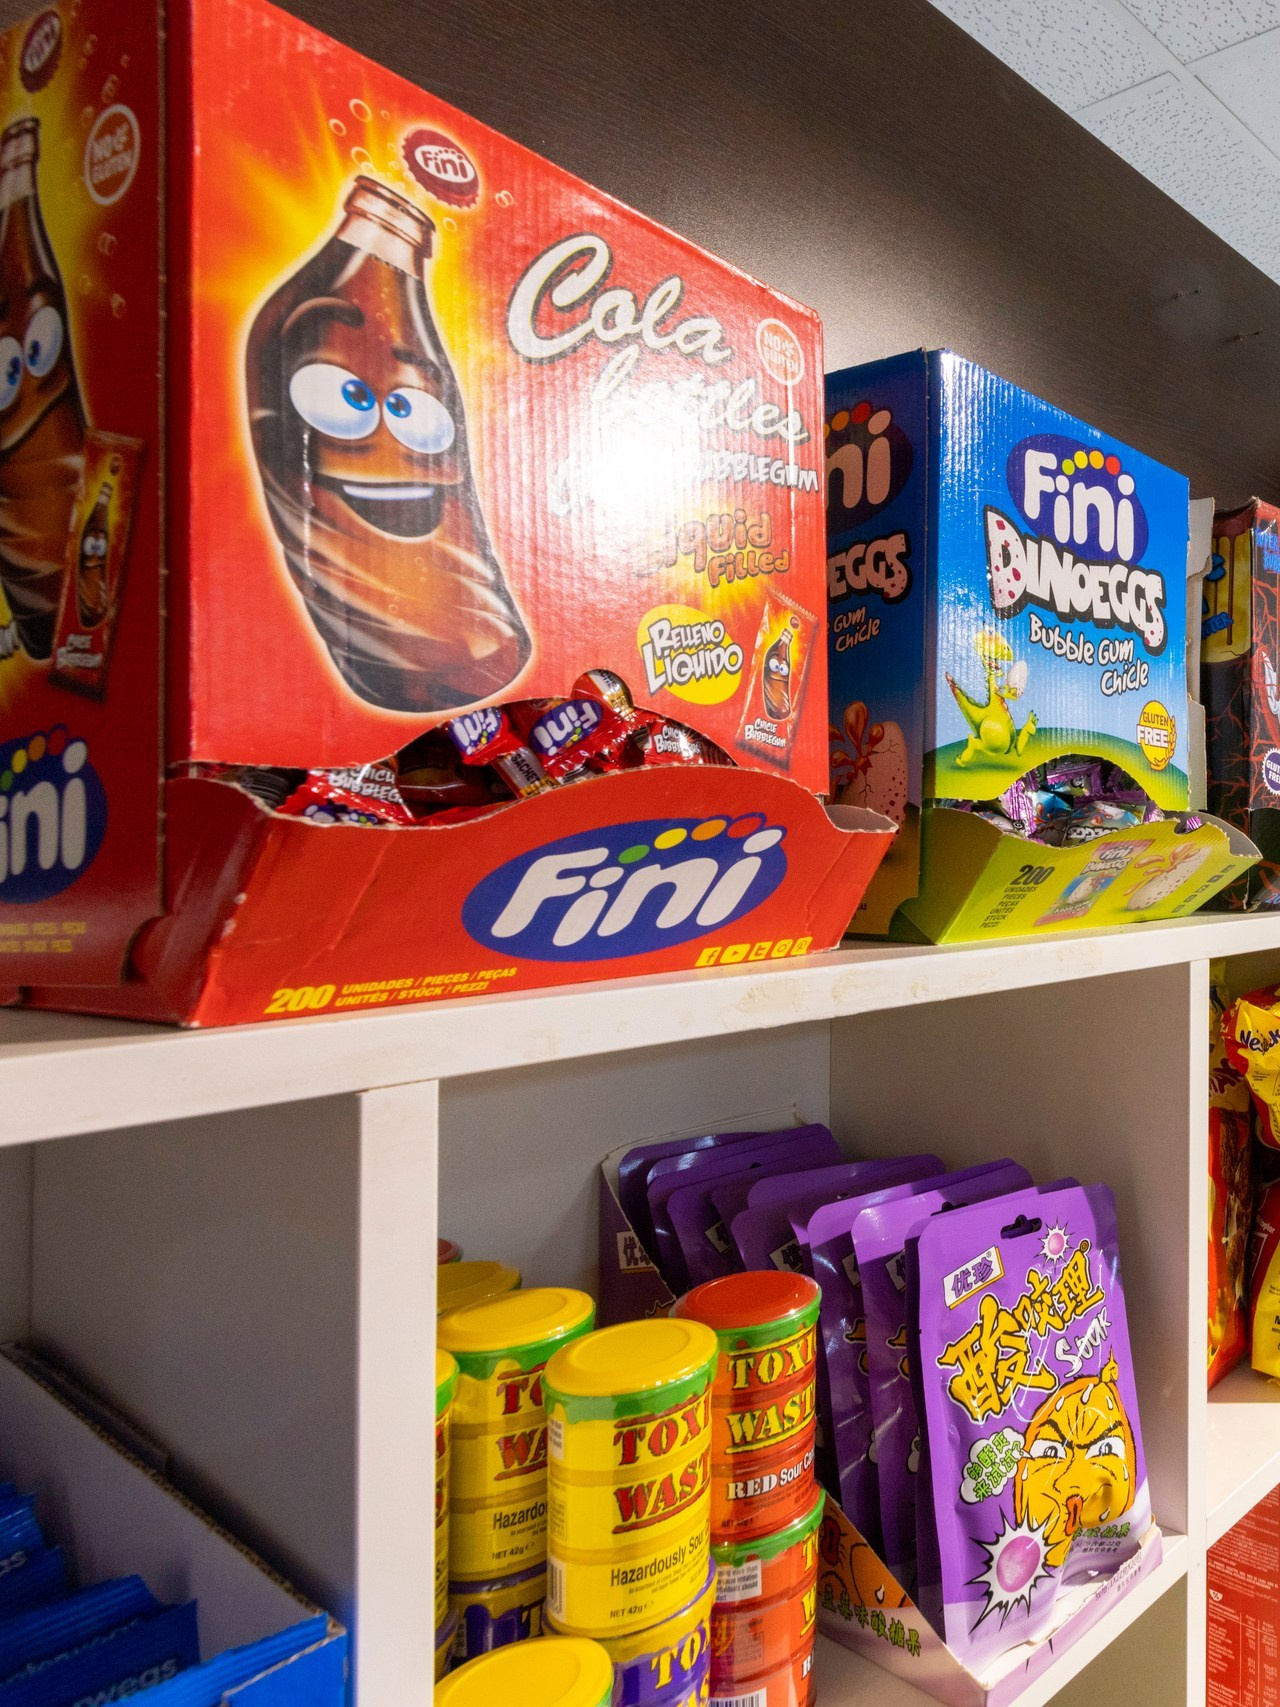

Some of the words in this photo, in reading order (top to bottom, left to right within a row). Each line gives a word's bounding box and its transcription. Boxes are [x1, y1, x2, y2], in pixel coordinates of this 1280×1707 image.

[421, 147, 468, 179] Fini
[508, 233, 731, 362] Cola
[698, 449, 818, 494] UBBLEGUM
[1024, 448, 1135, 562] Fini
[708, 549, 789, 588] Filled
[987, 510, 1165, 648] DINOEGGS
[1029, 613, 1094, 665] Bubble
[451, 708, 500, 756] Fini
[533, 702, 598, 757] Fini
[1136, 725, 1169, 748] FREE
[1141, 711, 1170, 728] GLUTEN
[491, 829, 785, 947] Fini
[1011, 864, 1056, 886] 200
[263, 984, 336, 1014] 200
[341, 977, 412, 995] UNIDADES
[422, 972, 470, 987] PIECES
[477, 967, 518, 983] PEÇAS
[450, 981, 489, 994] PEZZI
[951, 1256, 994, 1299] 优珍
[727, 1473, 778, 1500] RED
[780, 1461, 803, 1485] Sour
[611, 1545, 687, 1588] Hazardously
[609, 1607, 625, 1619] NET
[627, 1604, 643, 1617] 42g
